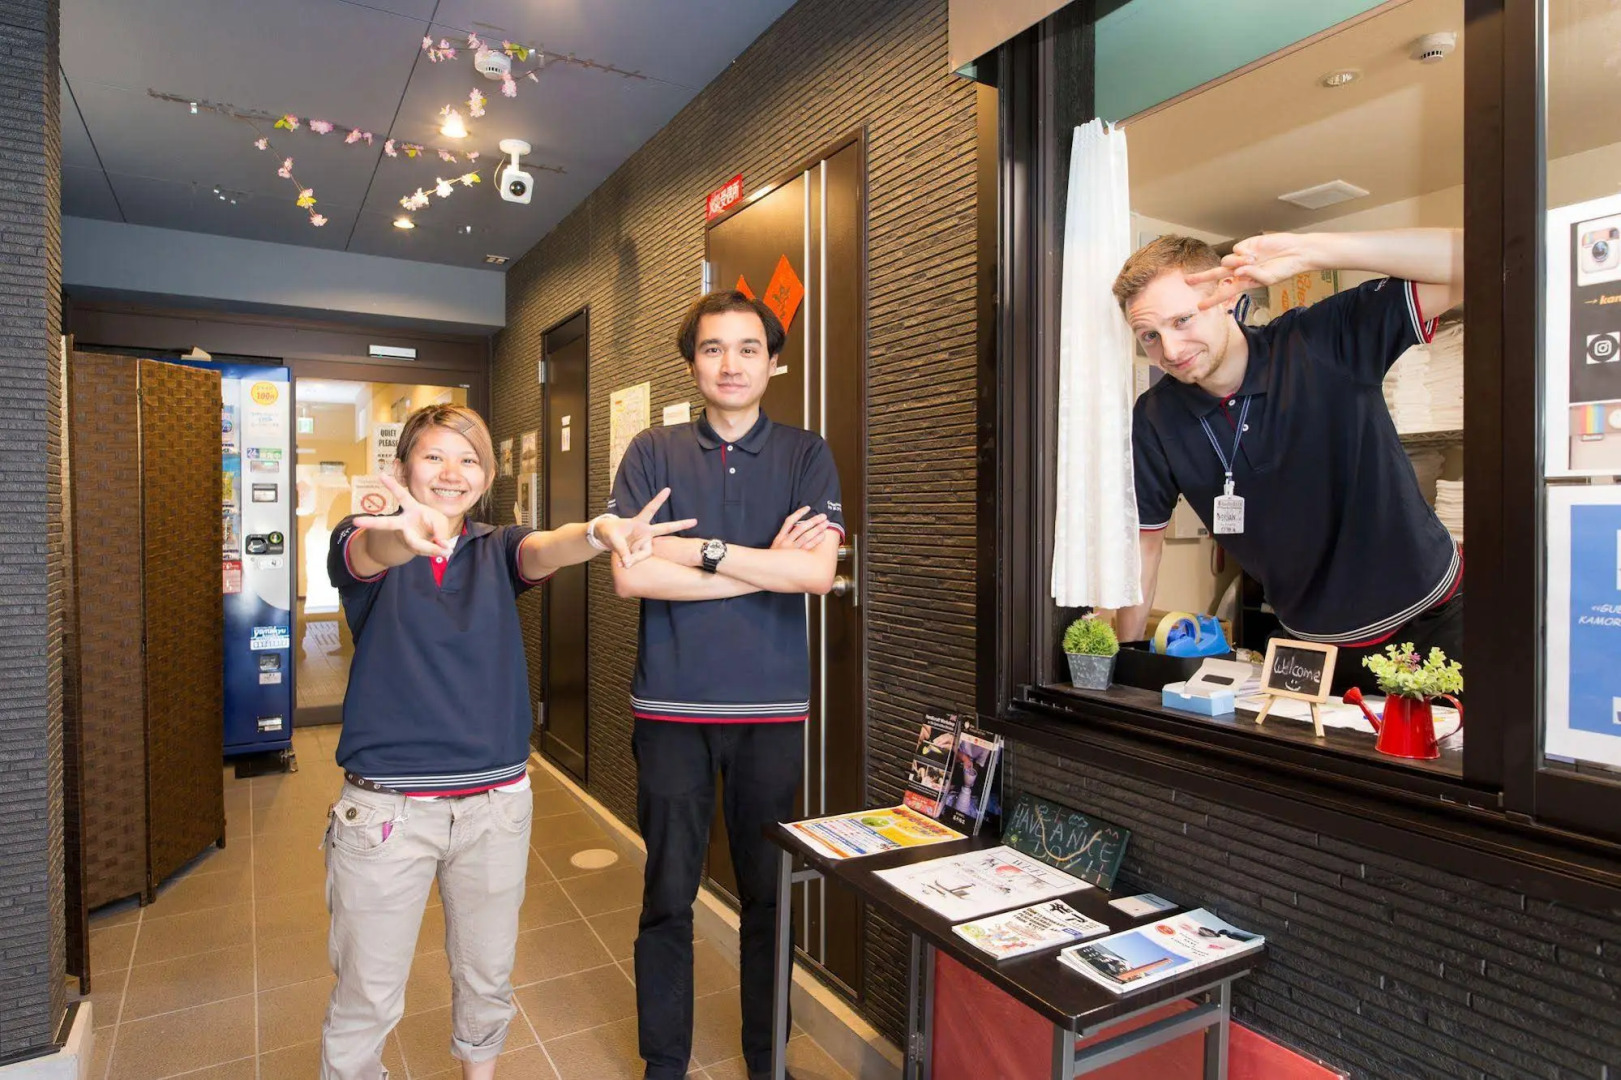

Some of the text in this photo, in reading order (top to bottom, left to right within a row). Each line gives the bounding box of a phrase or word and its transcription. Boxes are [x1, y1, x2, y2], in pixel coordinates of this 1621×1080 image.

[380, 428, 396, 437] QUIET
[1273, 656, 1321, 684] Welcome
[1011, 803, 1120, 863] HAVE A NICE
